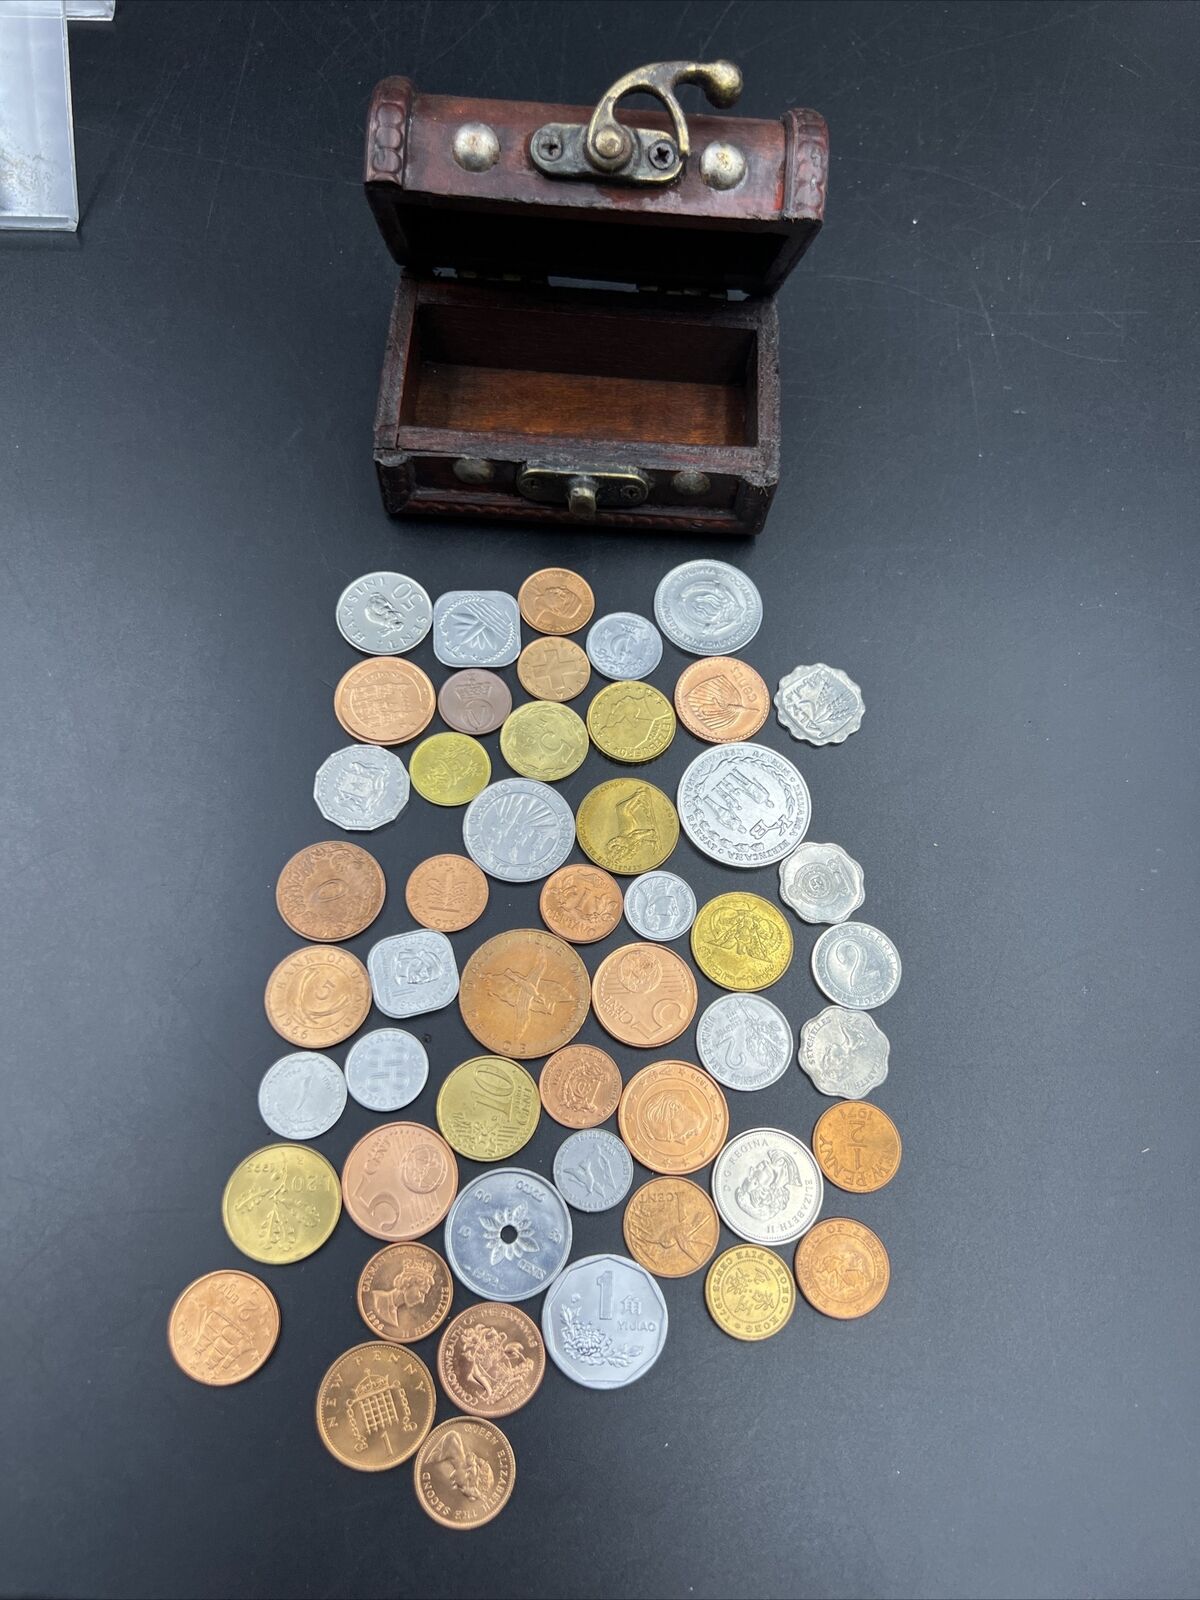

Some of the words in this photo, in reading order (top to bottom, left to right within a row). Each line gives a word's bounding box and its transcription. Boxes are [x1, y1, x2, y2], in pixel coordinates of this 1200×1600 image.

[391, 582, 423, 613] 50
[733, 662, 758, 706] cents
[749, 814, 794, 840] KB
[275, 950, 314, 991] BANK
[325, 949, 347, 963] OF
[313, 979, 337, 1002] 5
[333, 968, 369, 1039] UGANDA
[608, 994, 635, 1025] CENT
[630, 998, 688, 1039] 5
[721, 1034, 747, 1071] 2
[808, 1016, 832, 1067] SEYCHELLES
[470, 1063, 516, 1121] 10
[819, 1136, 868, 1188] PENNY
[352, 1175, 401, 1231] 5
[639, 1191, 673, 1205] CENT
[779, 1178, 815, 1233] ELIZABETH
[826, 1225, 844, 1235] OF
[362, 1255, 387, 1293] CAYMAN
[414, 1285, 450, 1336] ELIZABETH
[595, 1269, 615, 1321] 1
[621, 1294, 642, 1316] 角
[441, 1323, 480, 1406] COMMONWEALTH
[500, 1310, 539, 1349] BAHAMAS
[326, 1375, 344, 1429] NEW
[353, 1350, 427, 1398] PENNY
[380, 1431, 396, 1458] 1
[463, 1423, 500, 1447] QUEEN
[420, 1471, 451, 1515] SECOND
[480, 1449, 510, 1514] ELIZABETH
